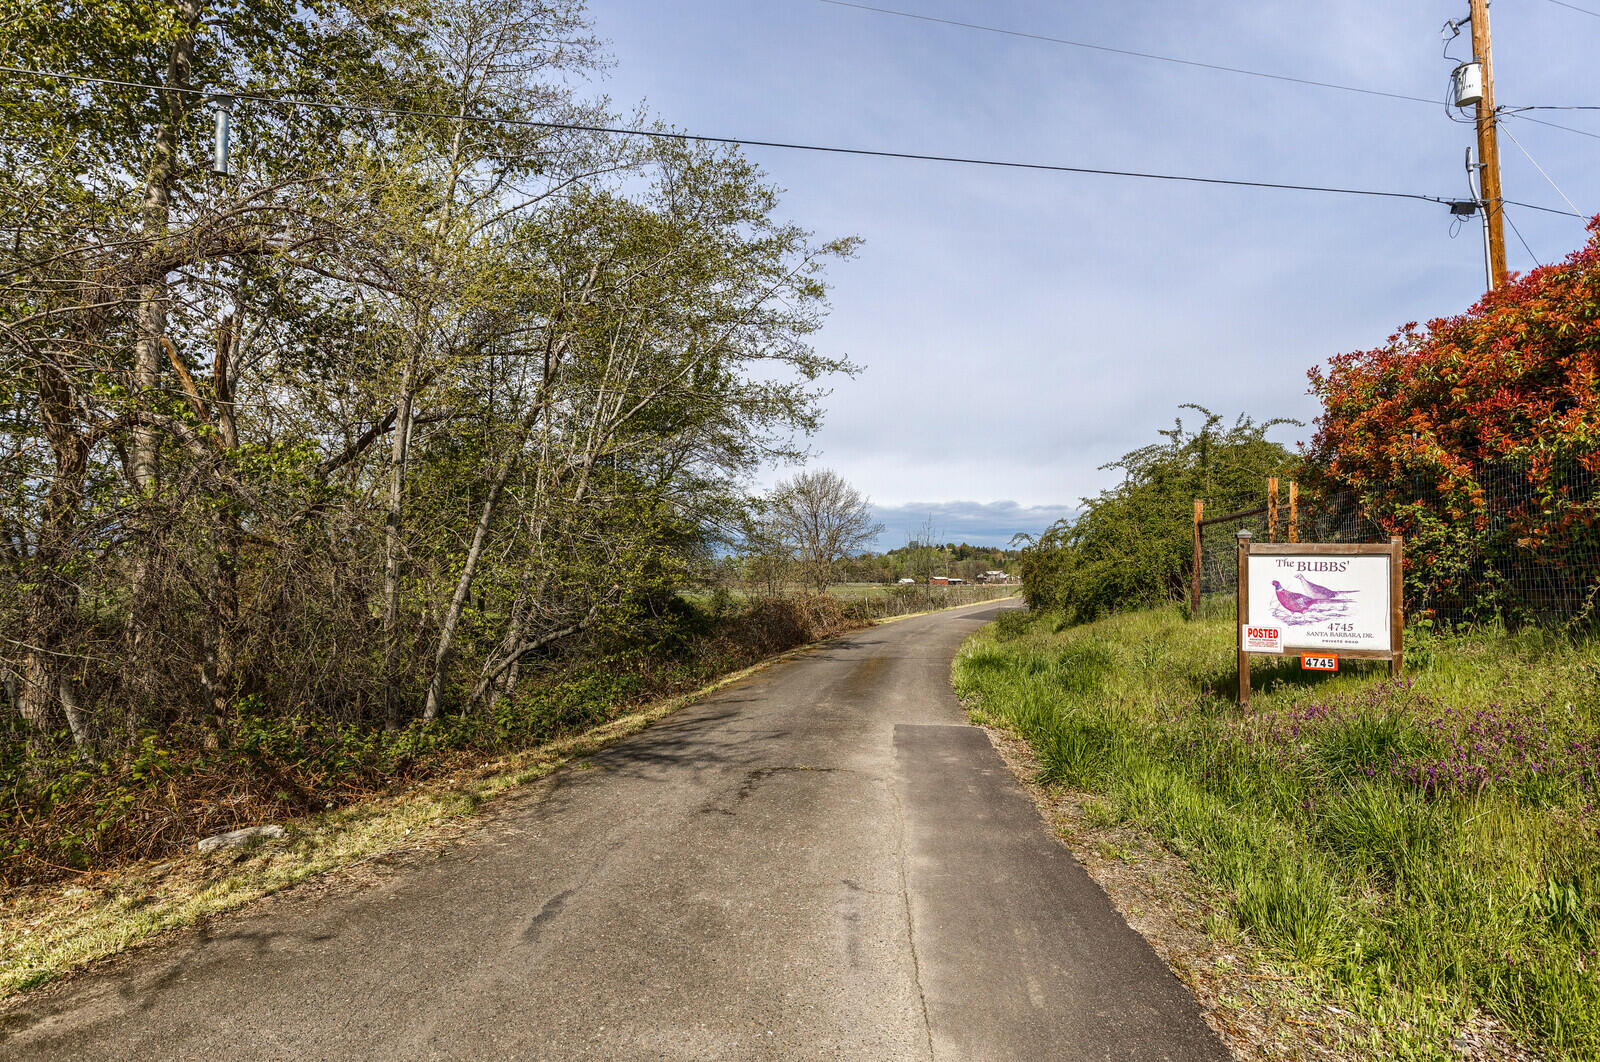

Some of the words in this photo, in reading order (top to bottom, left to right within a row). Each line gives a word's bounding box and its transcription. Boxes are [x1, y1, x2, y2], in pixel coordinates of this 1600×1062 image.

[1275, 558, 1295, 568] The
[1327, 623, 1354, 632] 4745
[1248, 628, 1278, 638] POSTED
[1305, 658, 1334, 668] 4745
